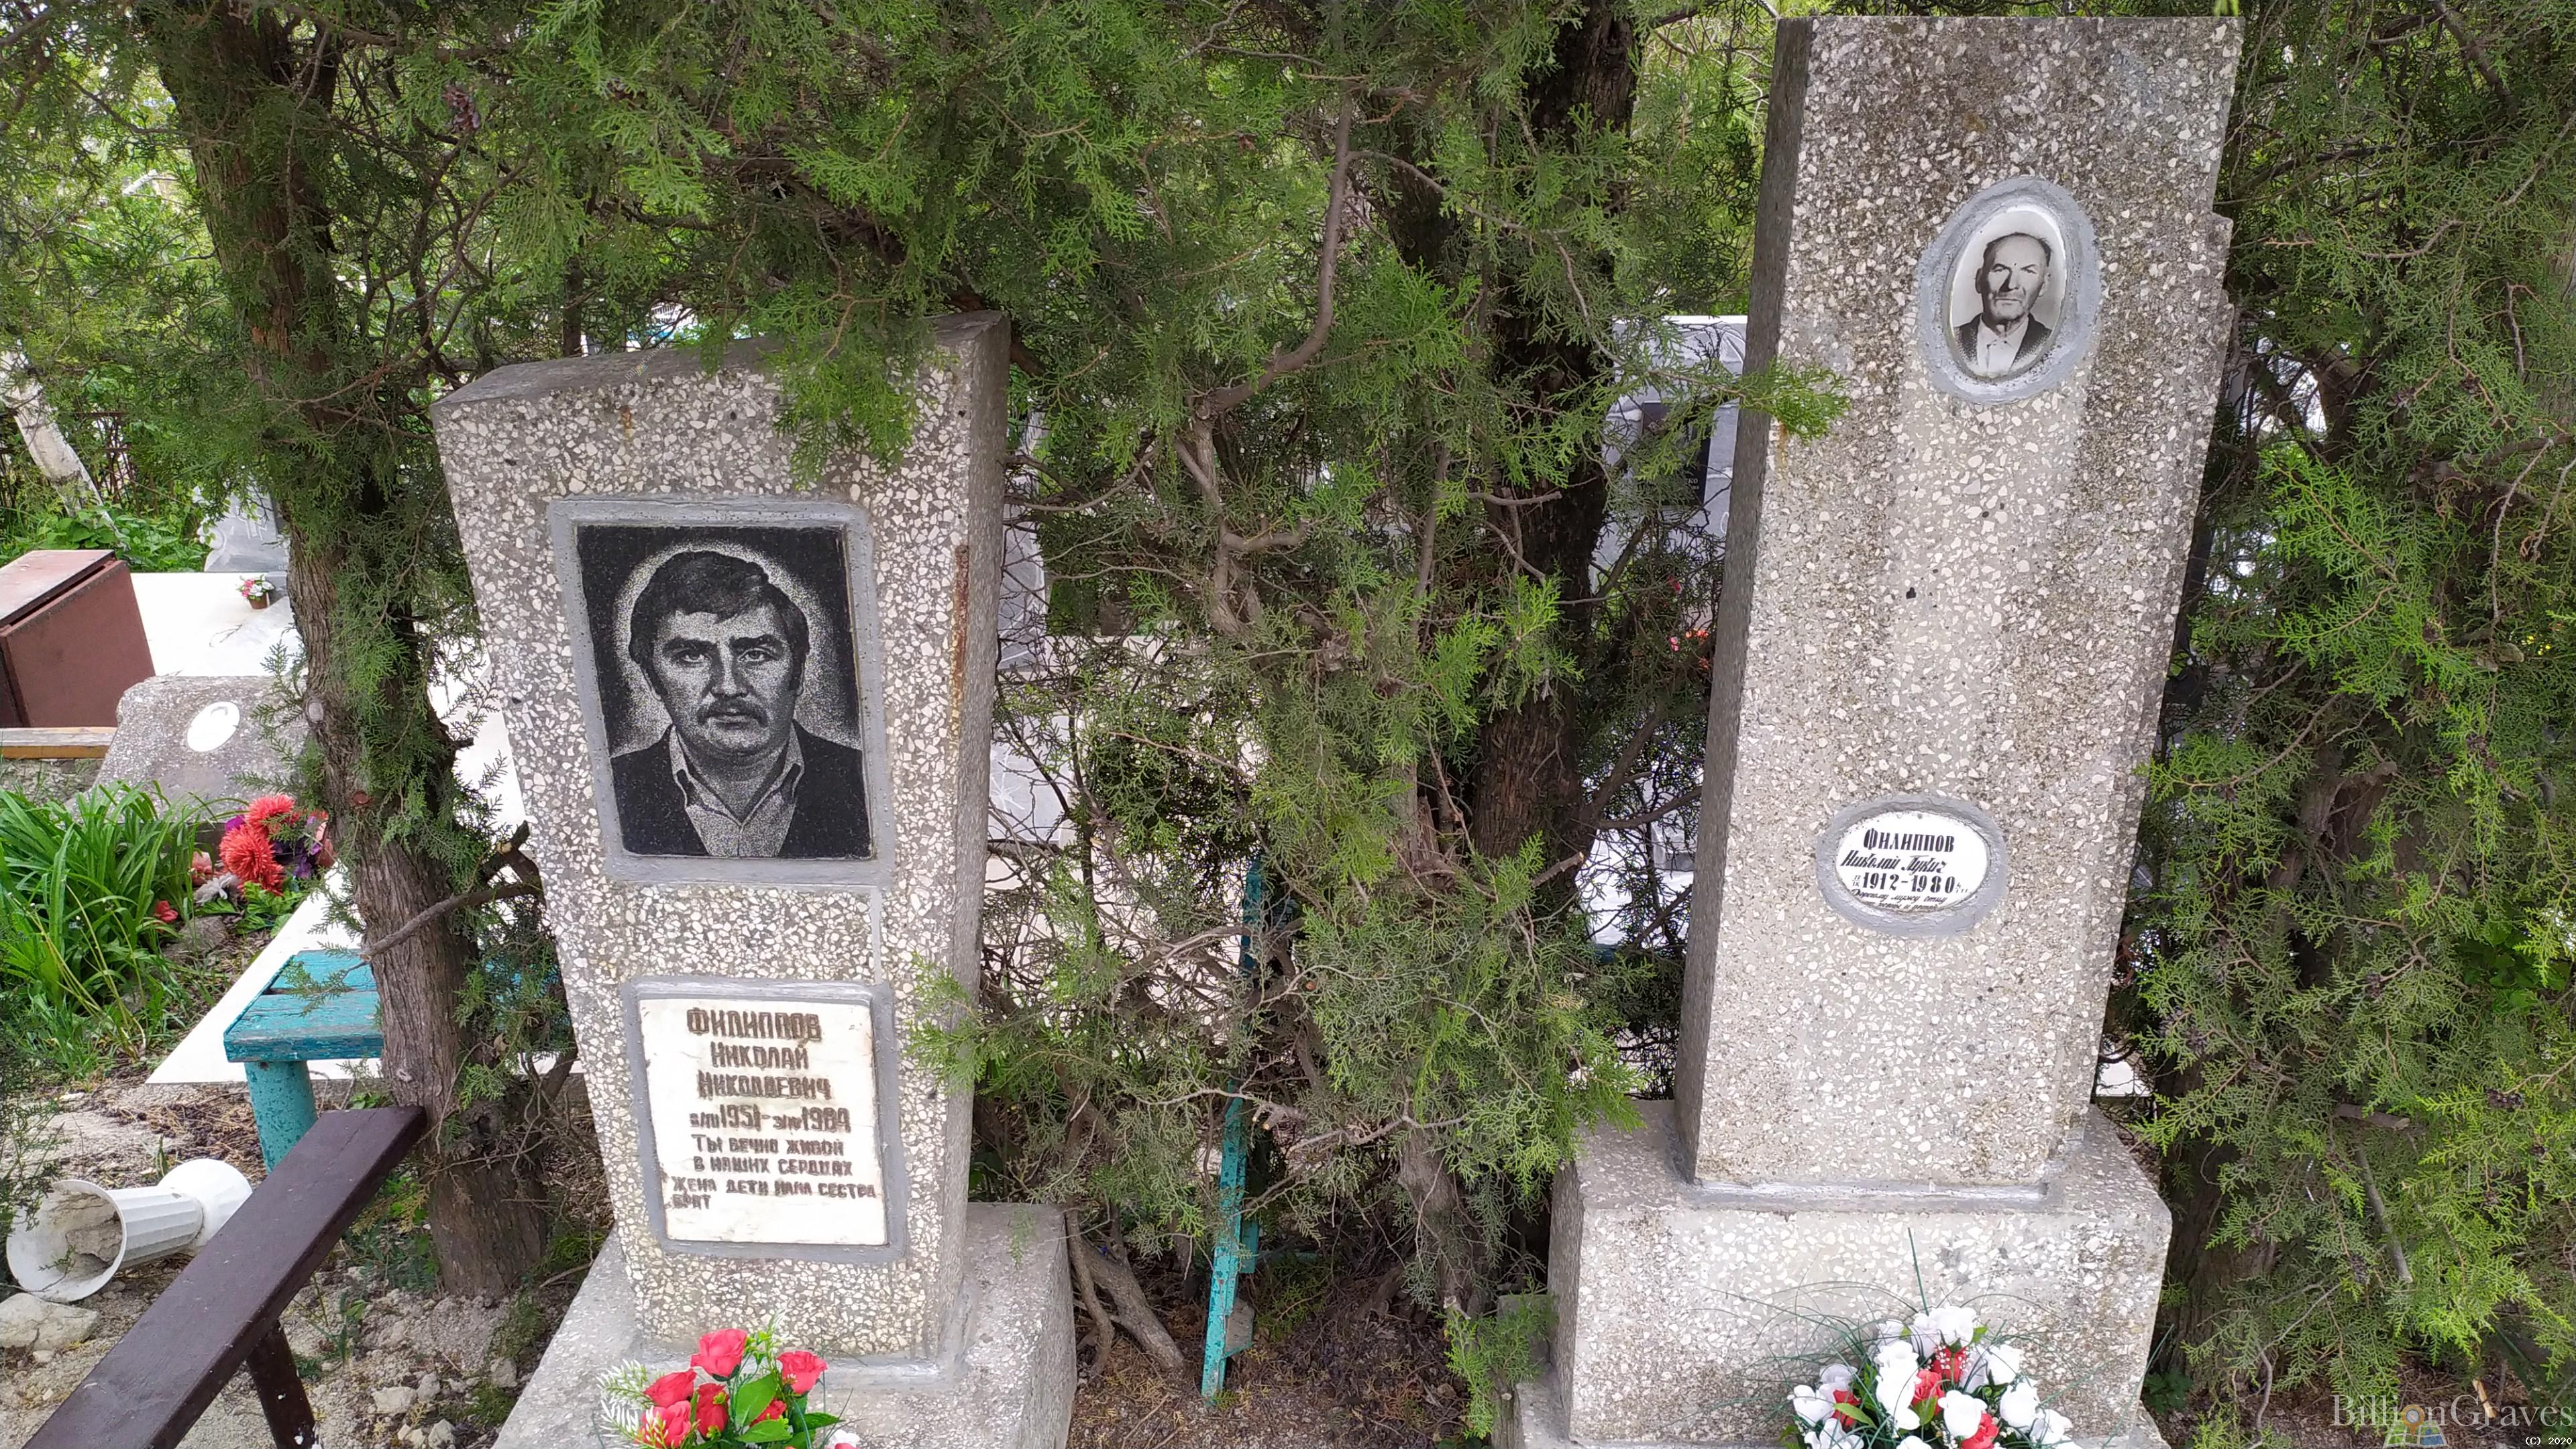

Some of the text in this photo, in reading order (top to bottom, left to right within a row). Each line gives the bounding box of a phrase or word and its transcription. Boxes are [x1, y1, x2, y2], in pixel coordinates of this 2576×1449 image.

[1864, 828, 1955, 853] ФИЛИППОВ
[1840, 850, 1900, 870] Николай
[686, 1008, 822, 1042] ФИЛИППОВ
[710, 1041, 809, 1071] НИКОЛАЙ
[697, 1071, 833, 1100] НИКОЛАЕВИЧ
[710, 1157, 770, 1173] НАШИХ
[778, 1159, 853, 1177] СЕРДЦАХ
[672, 1176, 716, 1193] ЖЕНА
[727, 1179, 769, 1196] ДЕТИ
[818, 1182, 877, 1199] СЕСТРА
